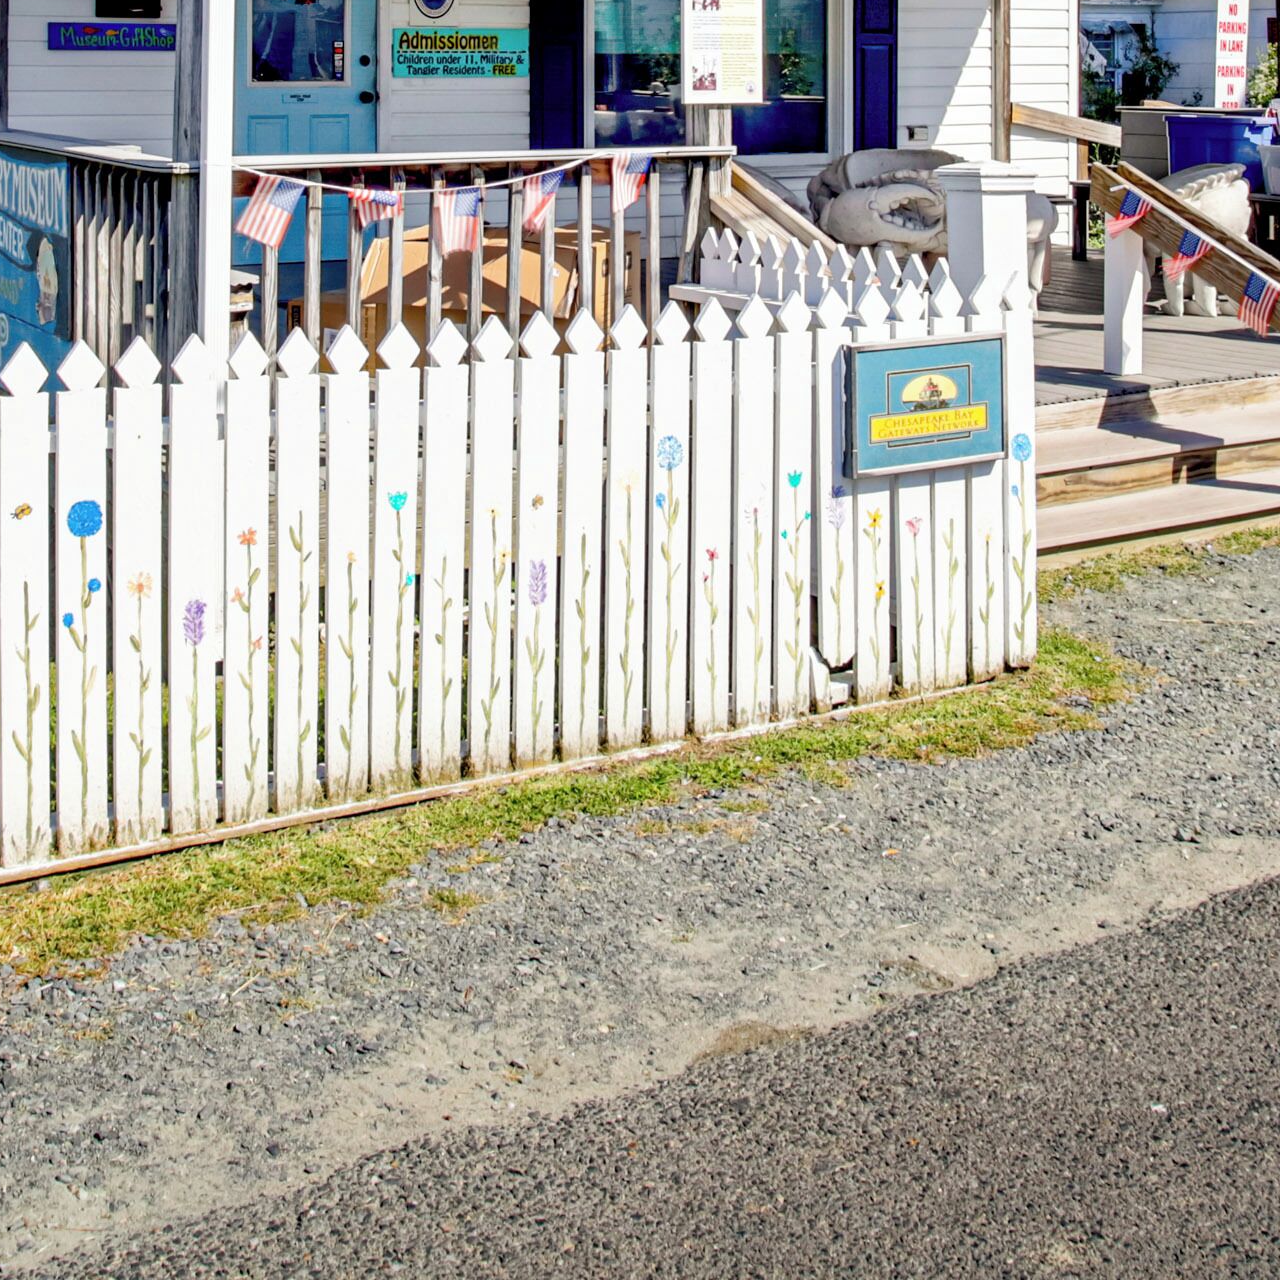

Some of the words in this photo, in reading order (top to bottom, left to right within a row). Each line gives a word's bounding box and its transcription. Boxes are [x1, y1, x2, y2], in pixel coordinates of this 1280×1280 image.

[1228, 3, 1238, 17] NO
[1218, 21, 1247, 34] PARKING
[1219, 39, 1227, 52] IN
[1228, 39, 1244, 53] LANE
[397, 54, 434, 65] Children
[437, 54, 461, 65] under
[480, 54, 514, 66] Military
[516, 55, 525, 65] &
[406, 65, 440, 76] Tangier
[442, 64, 486, 76] Residents
[493, 64, 517, 76] FREE
[1217, 65, 1245, 78] PARKING
[1227, 83, 1234, 96] IN
[12, 162, 68, 238] MUSEUM
